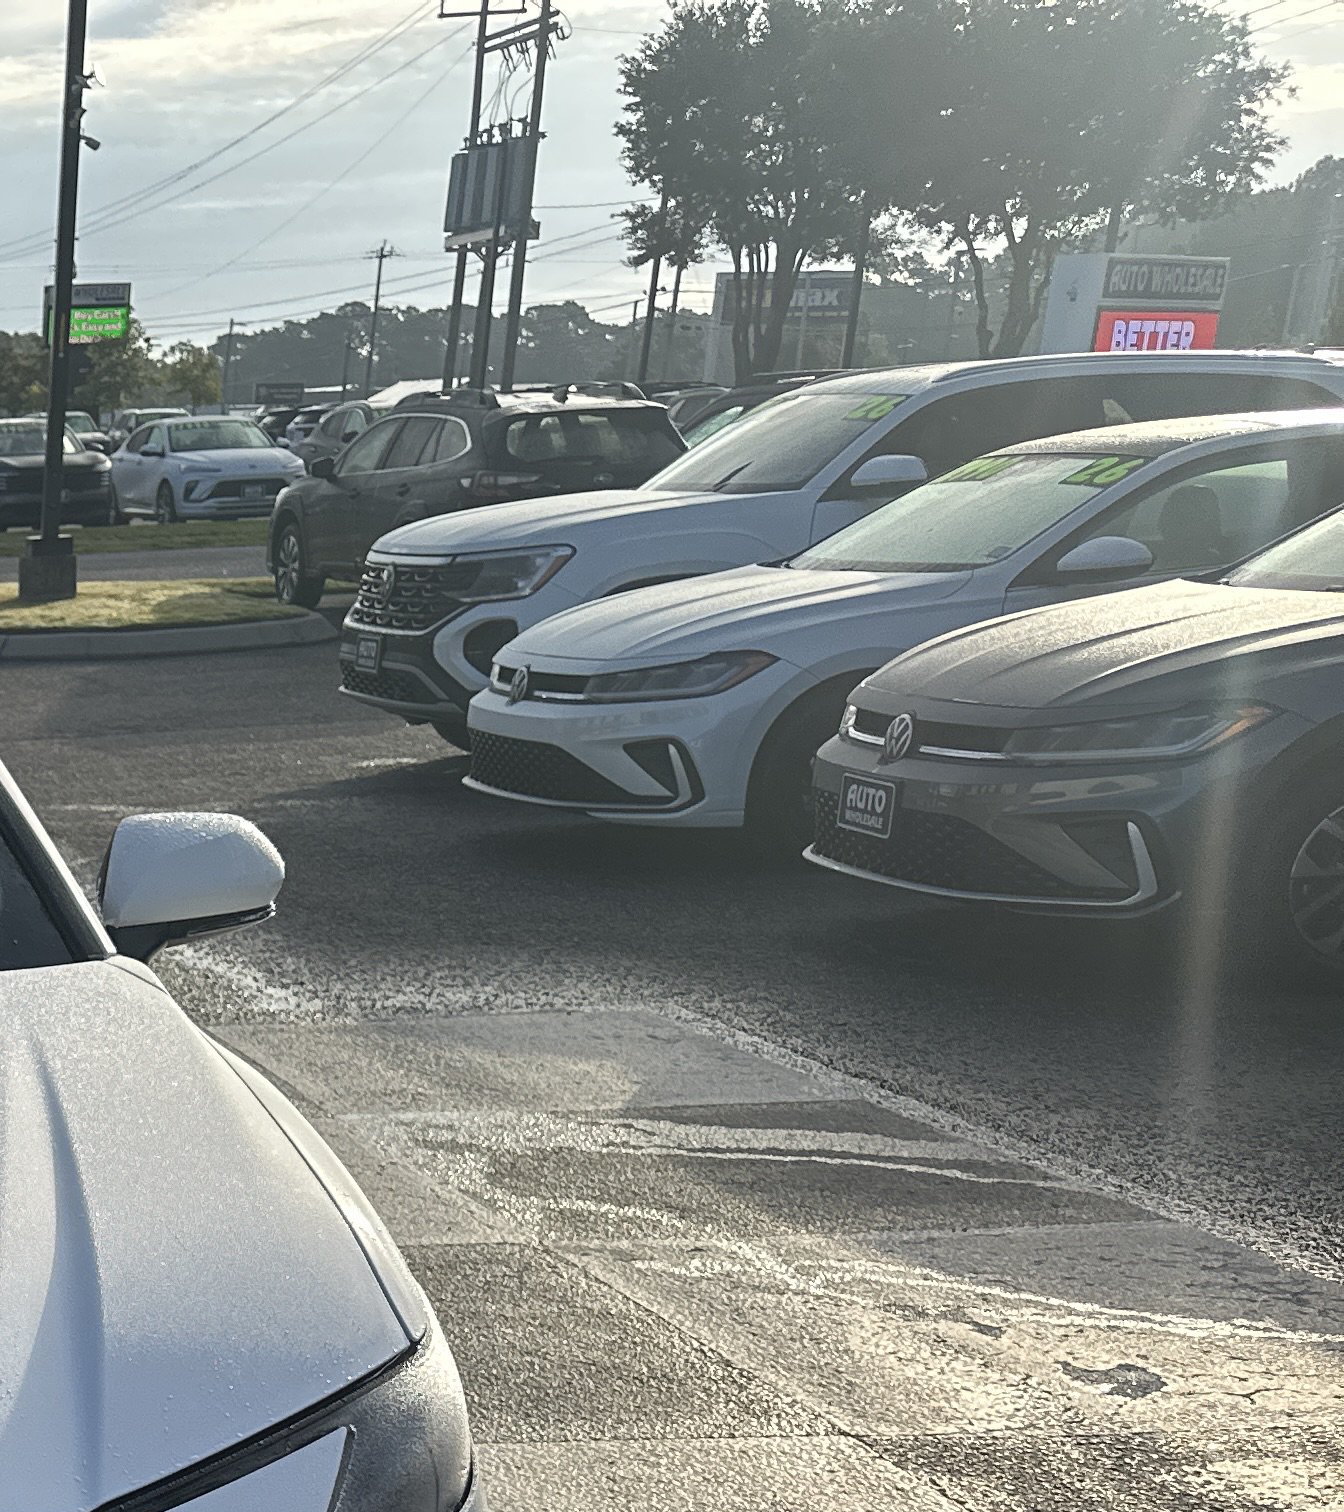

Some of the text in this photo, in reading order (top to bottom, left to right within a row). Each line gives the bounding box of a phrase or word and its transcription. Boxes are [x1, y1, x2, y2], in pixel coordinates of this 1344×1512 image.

[1109, 263, 1225, 296] AUTO WHOLESALE
[1109, 319, 1196, 351] BETTER
[1065, 456, 1145, 484] 26
[846, 784, 886, 813] AUTO
[845, 809, 883, 829] WHOLESALE
